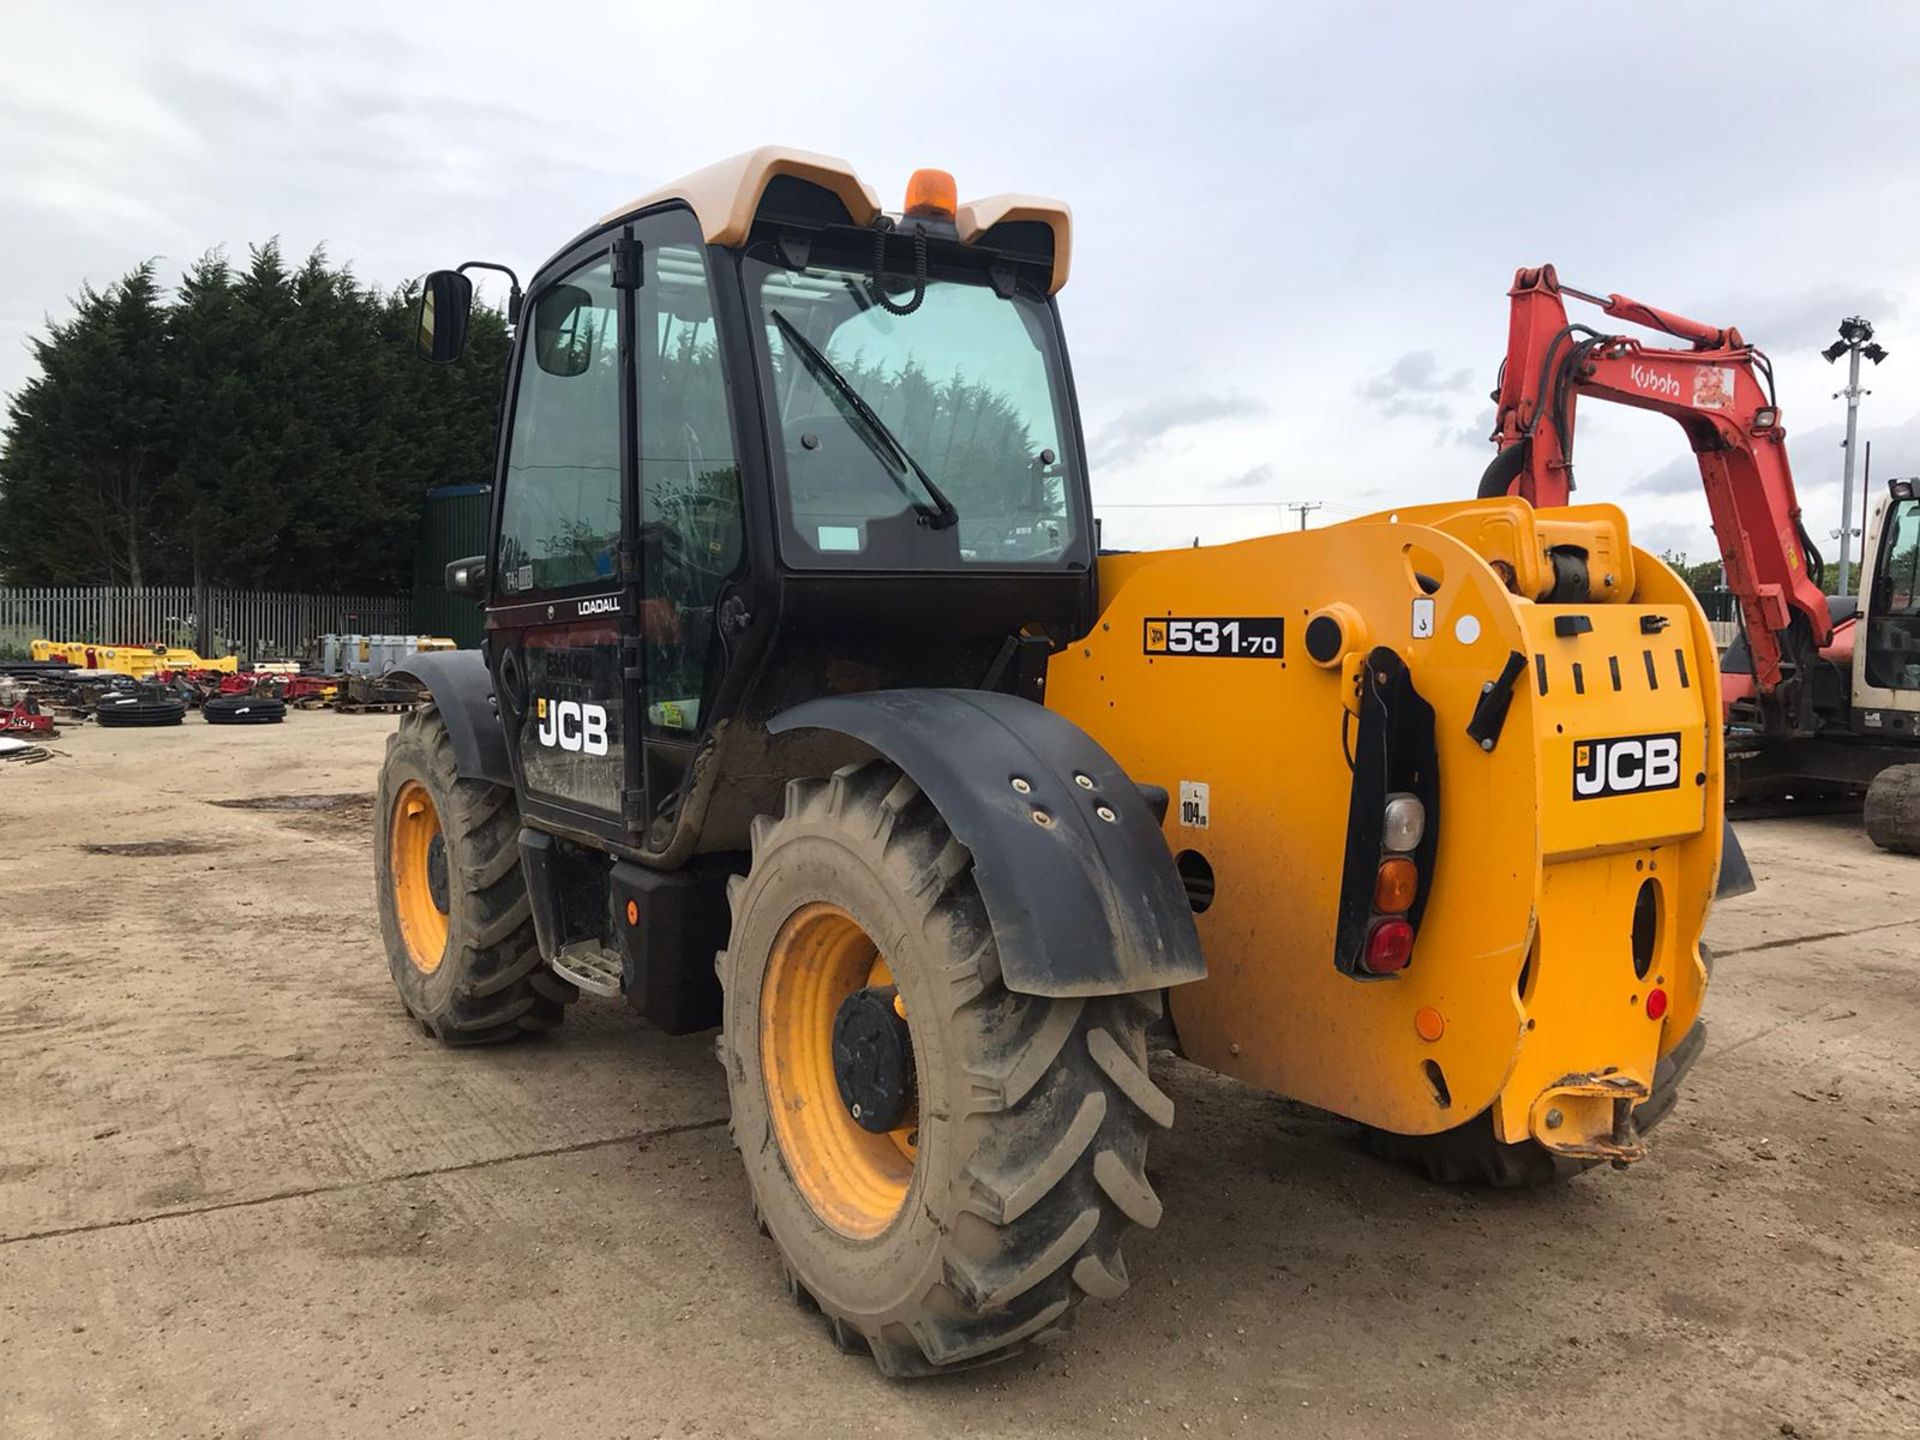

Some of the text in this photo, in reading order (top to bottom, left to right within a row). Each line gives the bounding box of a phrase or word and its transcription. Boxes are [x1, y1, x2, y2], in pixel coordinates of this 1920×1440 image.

[1630, 363, 1680, 397] Kubota
[577, 597, 621, 616] LOADALL
[1168, 621, 1277, 654] 531-70
[538, 699, 608, 757] JCB
[1576, 738, 1678, 795] JCB
[1182, 801, 1200, 825] 104
